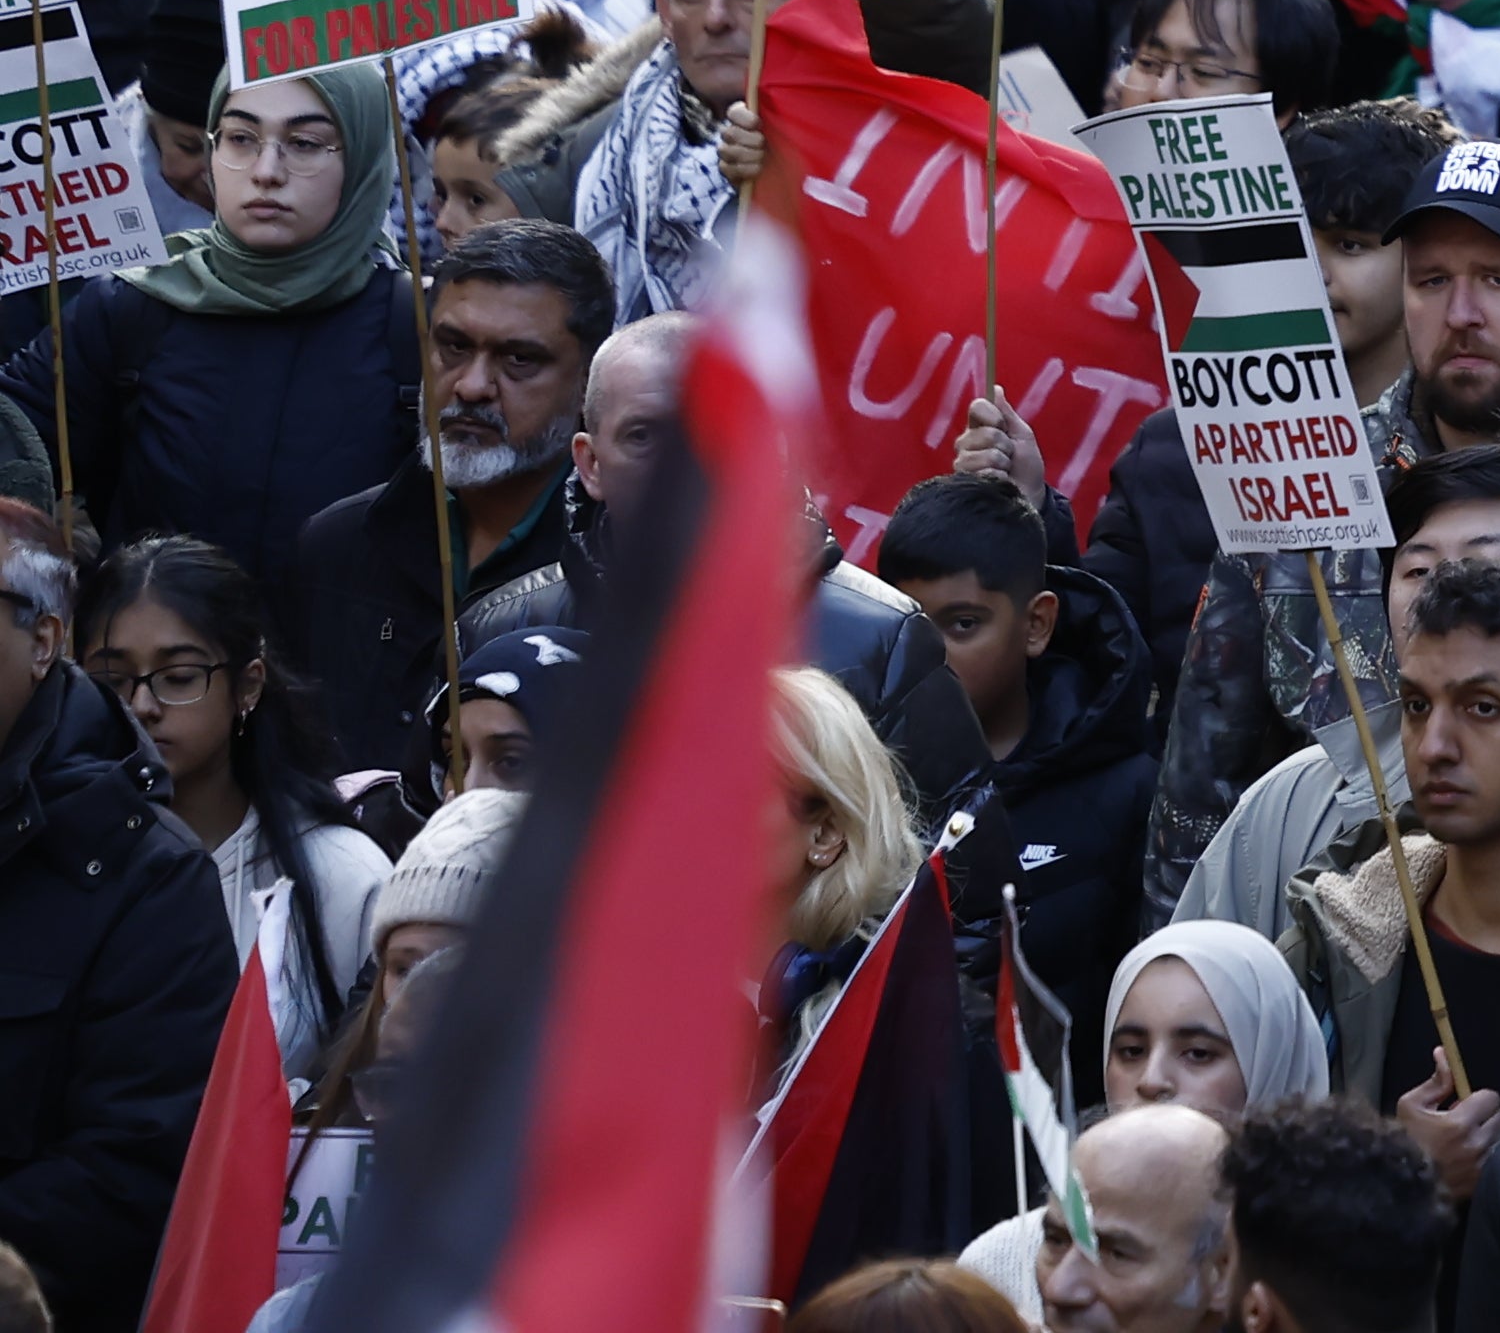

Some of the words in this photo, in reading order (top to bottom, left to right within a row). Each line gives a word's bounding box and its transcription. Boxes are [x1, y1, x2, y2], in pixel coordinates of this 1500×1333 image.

[243, 22, 317, 84] FOR
[1147, 113, 1227, 165] FREE
[1443, 156, 1472, 173] OF
[1474, 159, 1500, 173] A
[1121, 163, 1295, 221] PALESTINE
[1435, 168, 1500, 196] DOWN
[1171, 348, 1345, 408] BOYCOTT
[1195, 415, 1359, 466] APARTHEID
[1228, 472, 1349, 523] ISRAEL
[1023, 843, 1058, 860] NIKE
